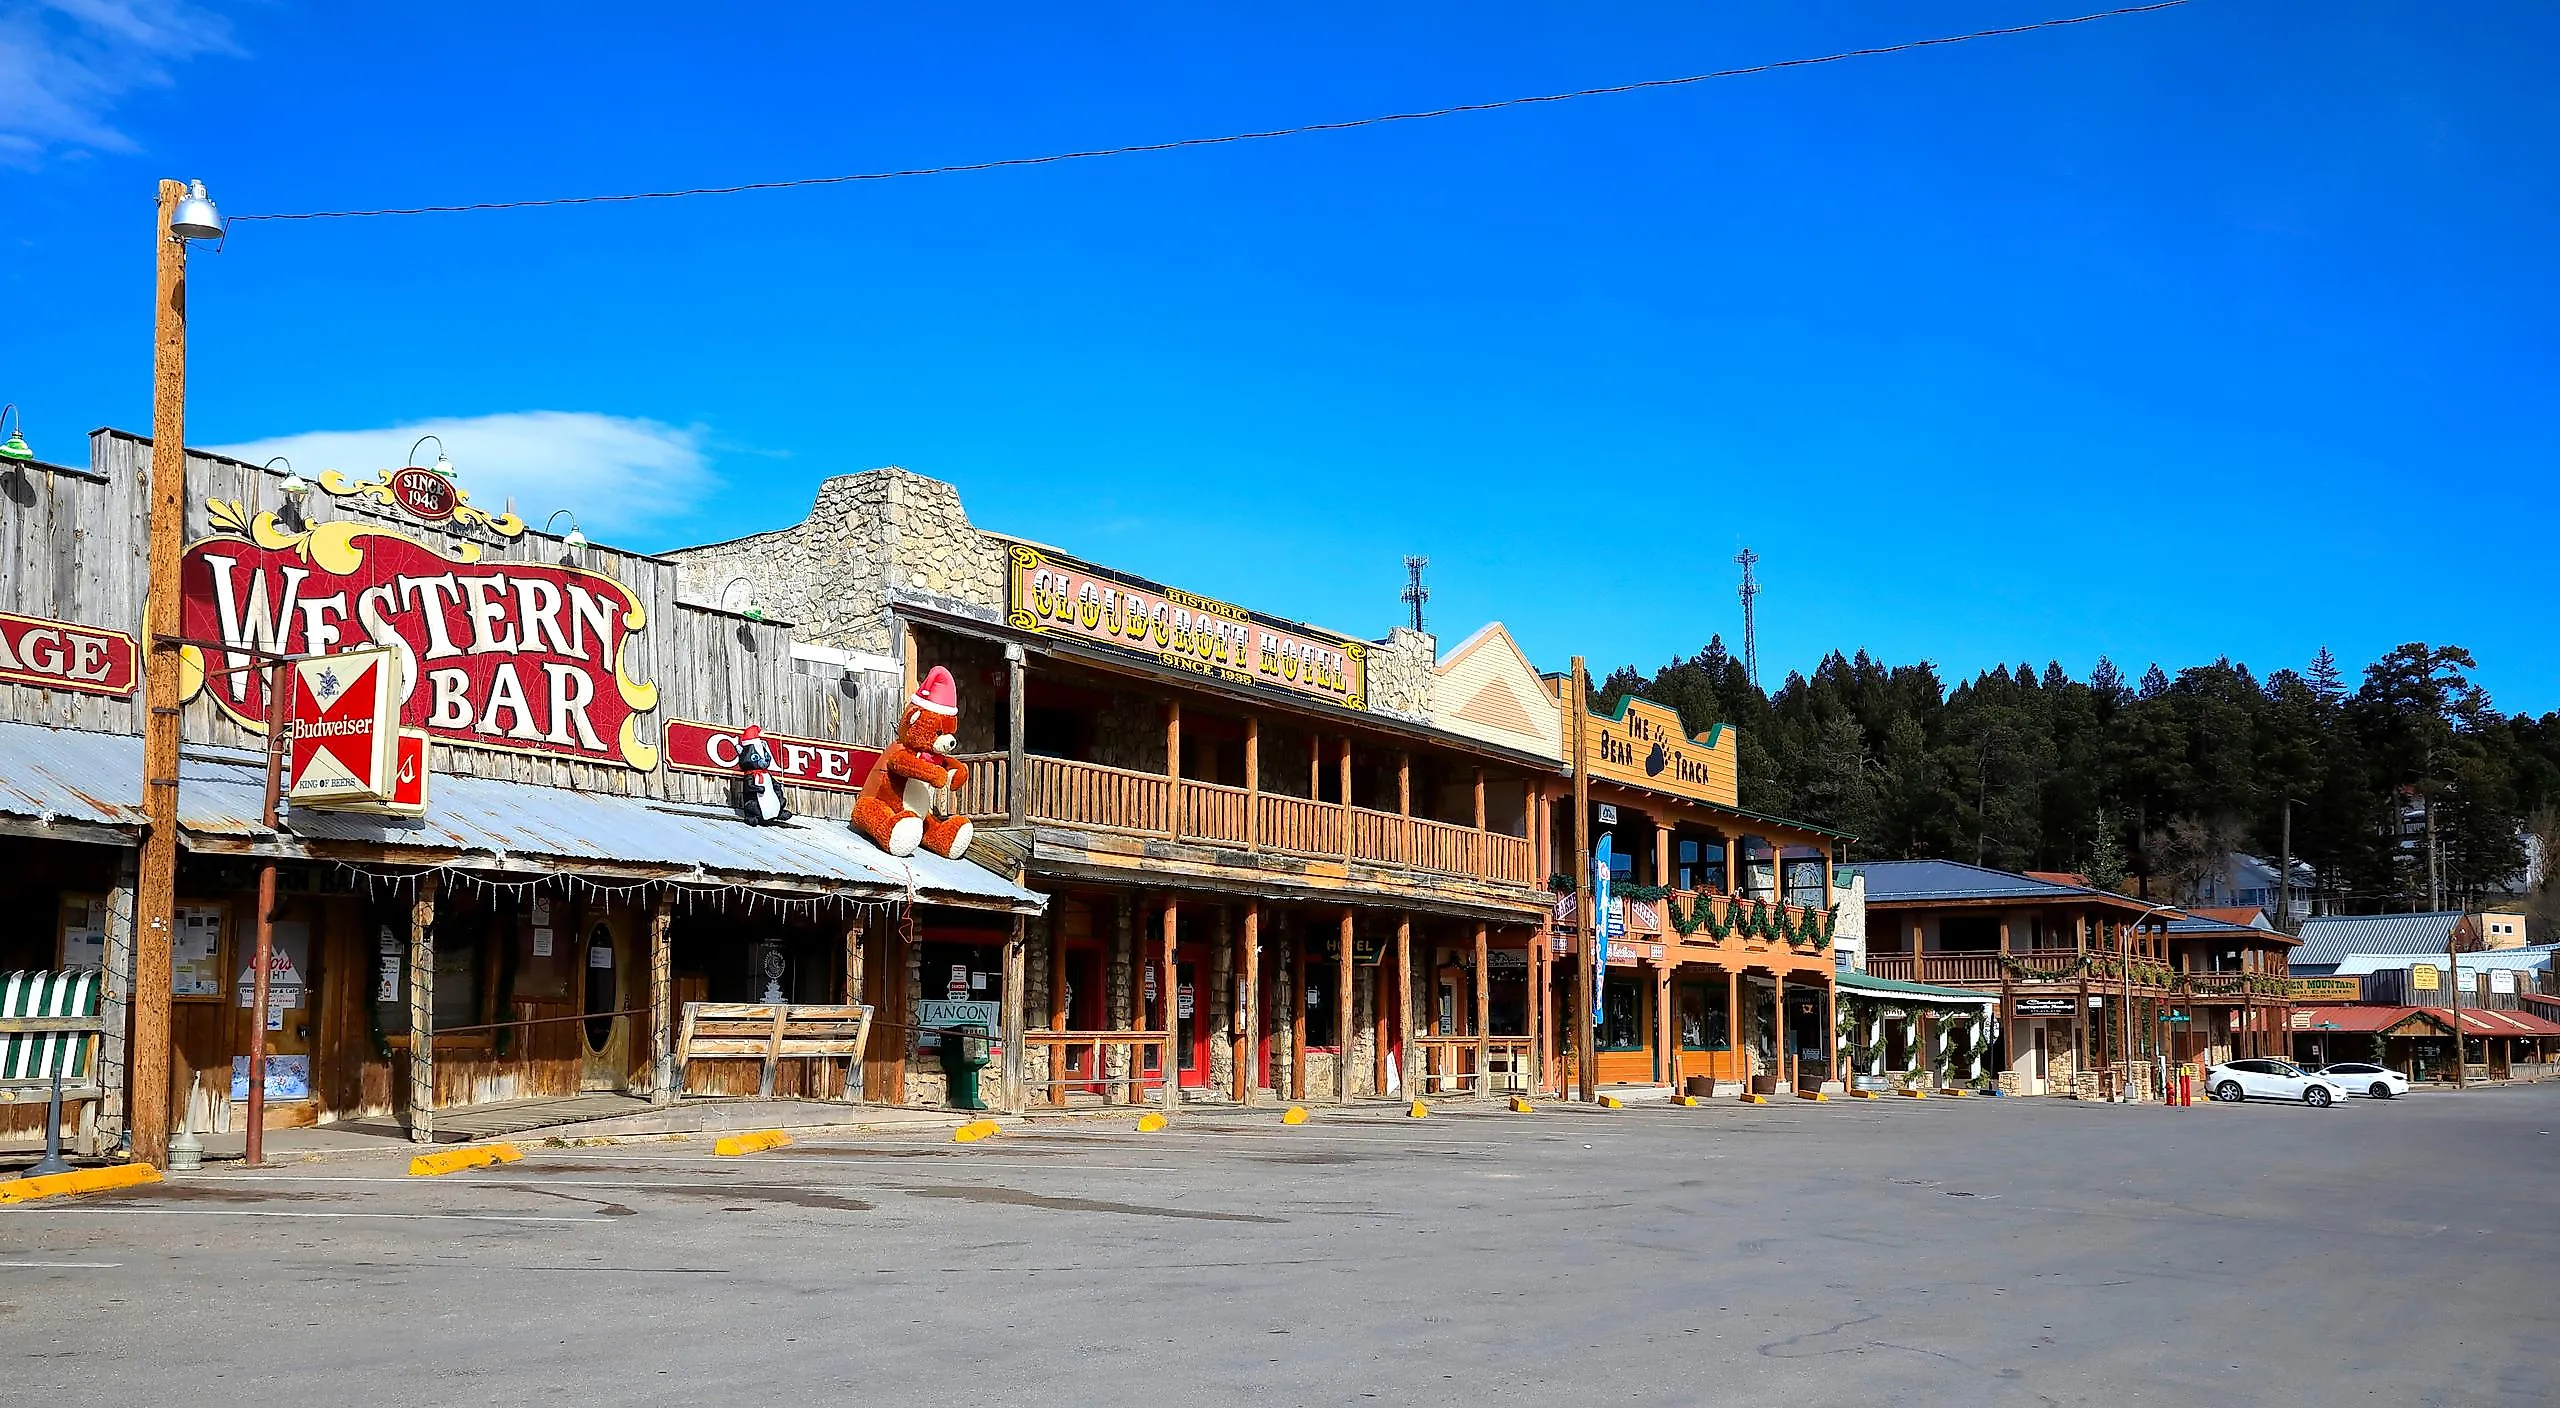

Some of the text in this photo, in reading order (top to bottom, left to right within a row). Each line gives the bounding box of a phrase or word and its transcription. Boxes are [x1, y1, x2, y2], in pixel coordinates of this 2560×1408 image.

[403, 474, 446, 496] SINCE
[408, 490, 439, 511] 1948
[1168, 591, 1248, 622] HISTORIC
[203, 553, 619, 706] WESTERN
[1031, 568, 1347, 694] CLOUDCROFT HOTEL
[1162, 653, 1214, 676] SINCE
[428, 661, 609, 752] BAR
[294, 713, 373, 740] Budweiser
[1627, 707, 1649, 741] THE
[1600, 728, 1709, 785] BEAR TRACK
[299, 777, 357, 790] KING OF BEERS
[1326, 939, 1374, 952] HEL
[249, 952, 292, 971] Cors
[922, 1003, 990, 1023] LANCON
